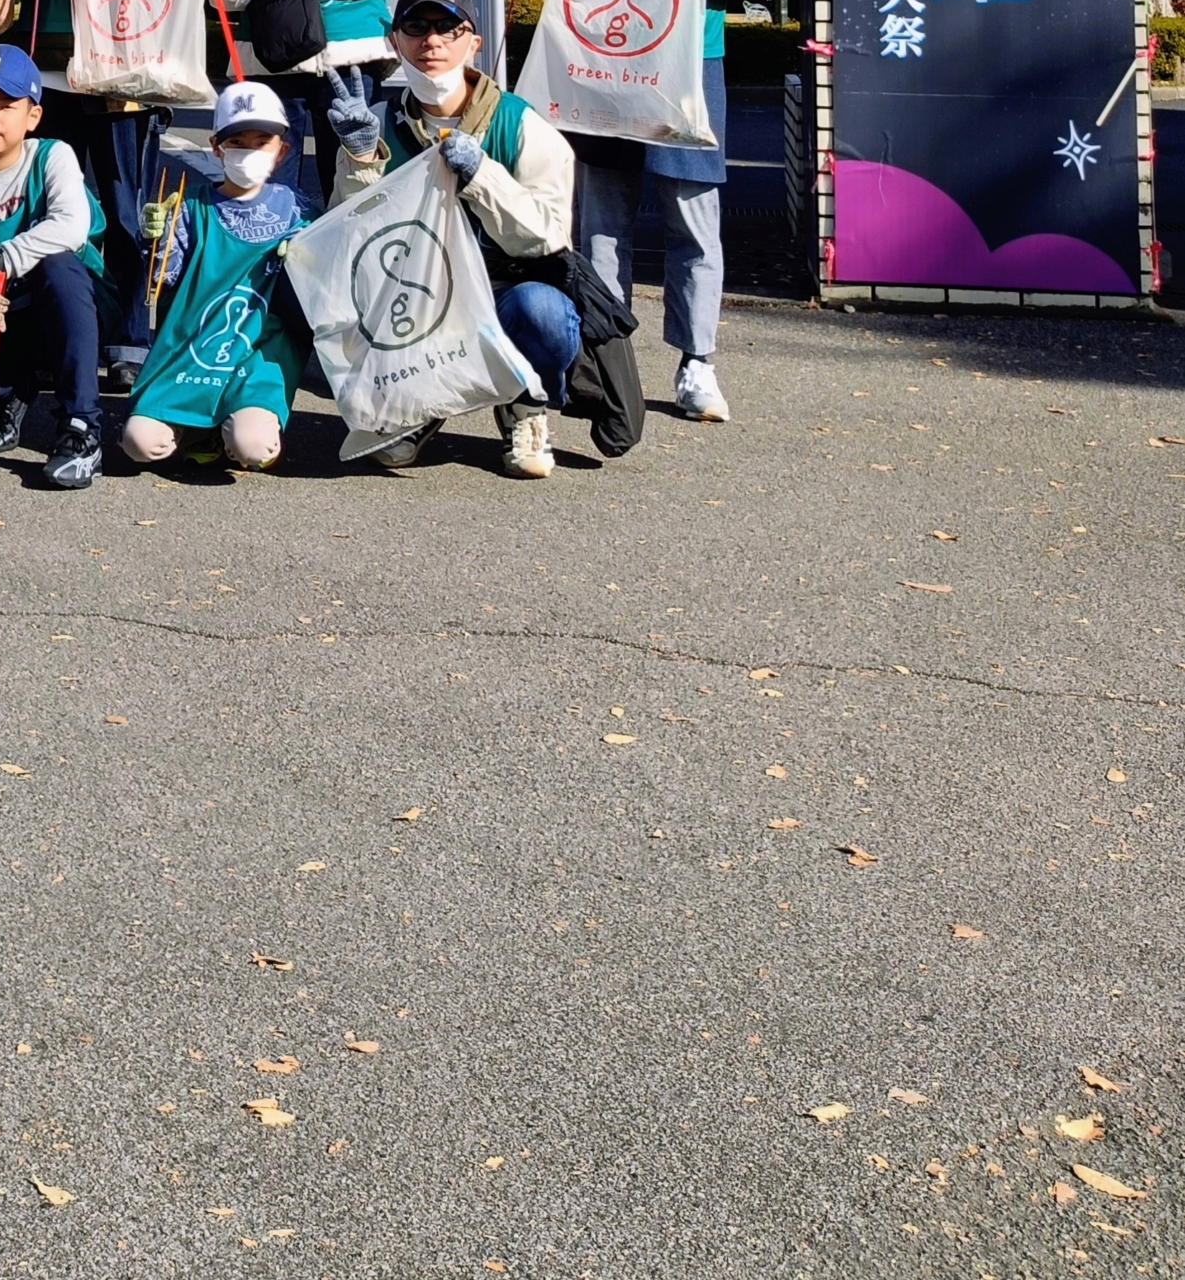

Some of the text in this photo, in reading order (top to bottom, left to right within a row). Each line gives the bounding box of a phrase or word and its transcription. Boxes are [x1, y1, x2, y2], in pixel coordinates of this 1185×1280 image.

[567, 63, 660, 86] green bird
[373, 340, 467, 391] green bird
[176, 371, 223, 387] green
